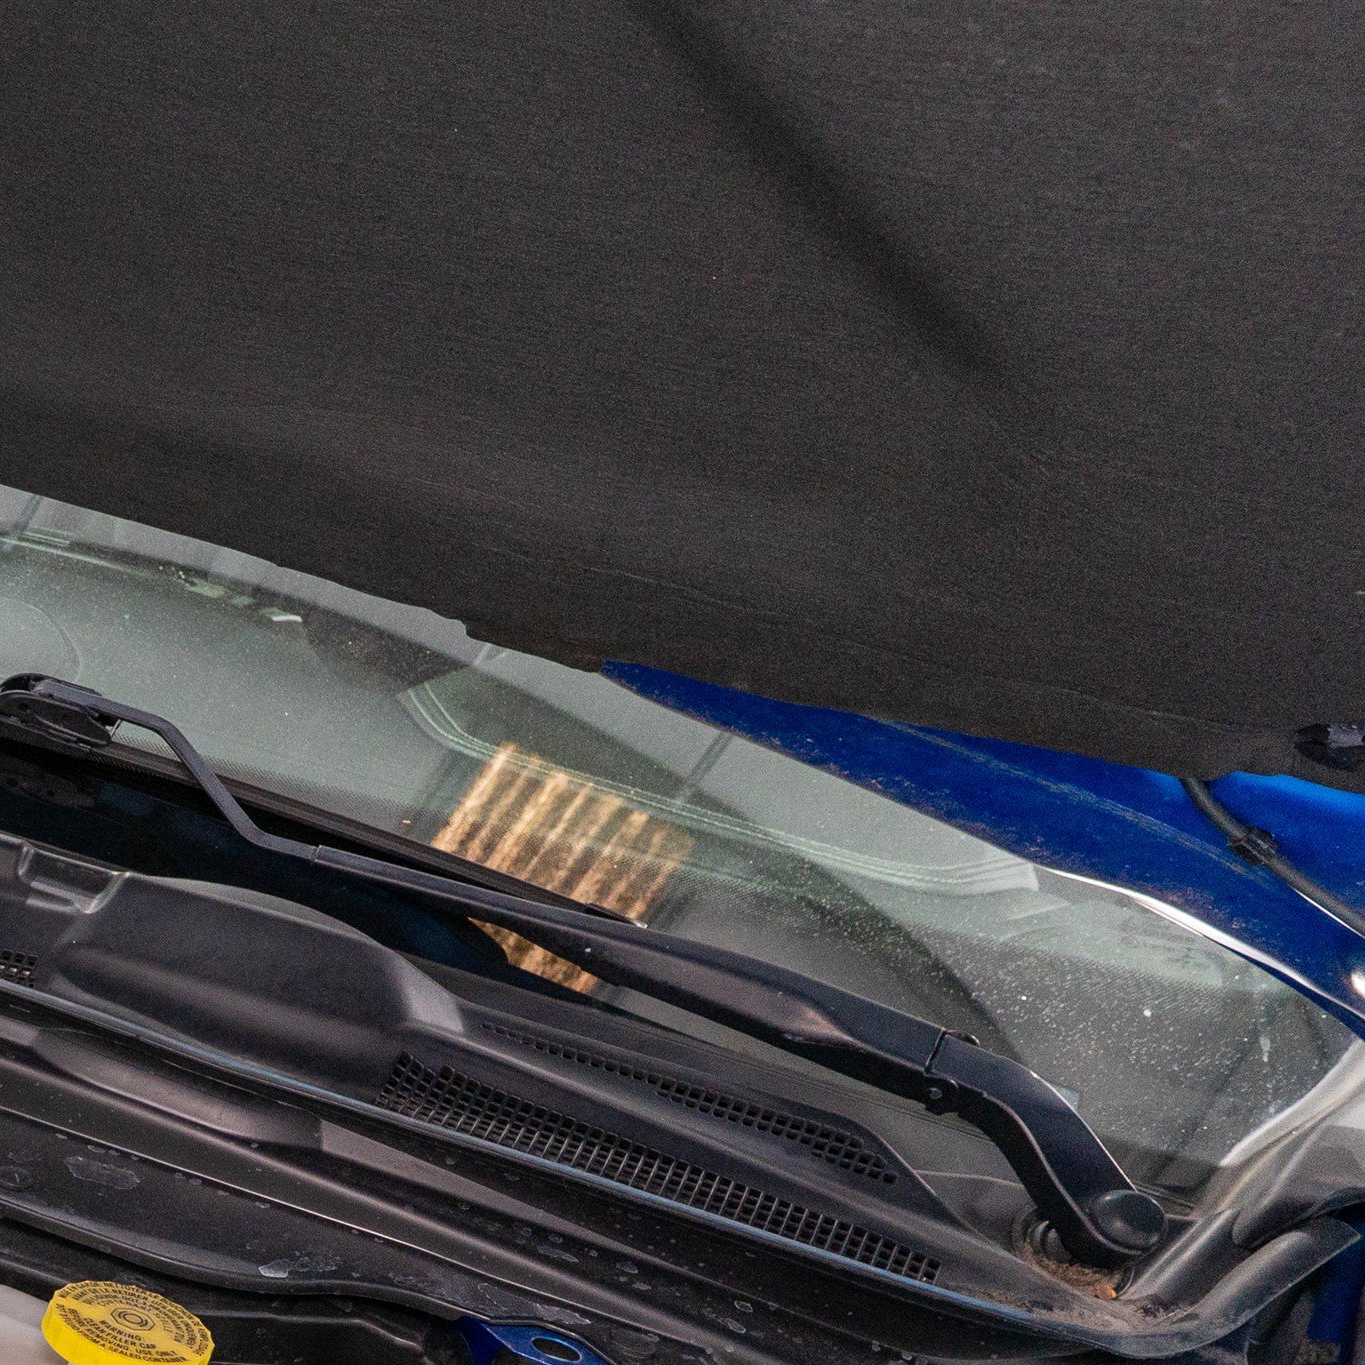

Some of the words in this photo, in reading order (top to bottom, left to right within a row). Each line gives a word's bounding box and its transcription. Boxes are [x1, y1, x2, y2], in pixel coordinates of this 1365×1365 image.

[83, 1317, 106, 1334] CLEAN
[105, 1332, 136, 1346] FILLER
[107, 1345, 141, 1360] SEALED
[135, 1347, 153, 1355] USE
